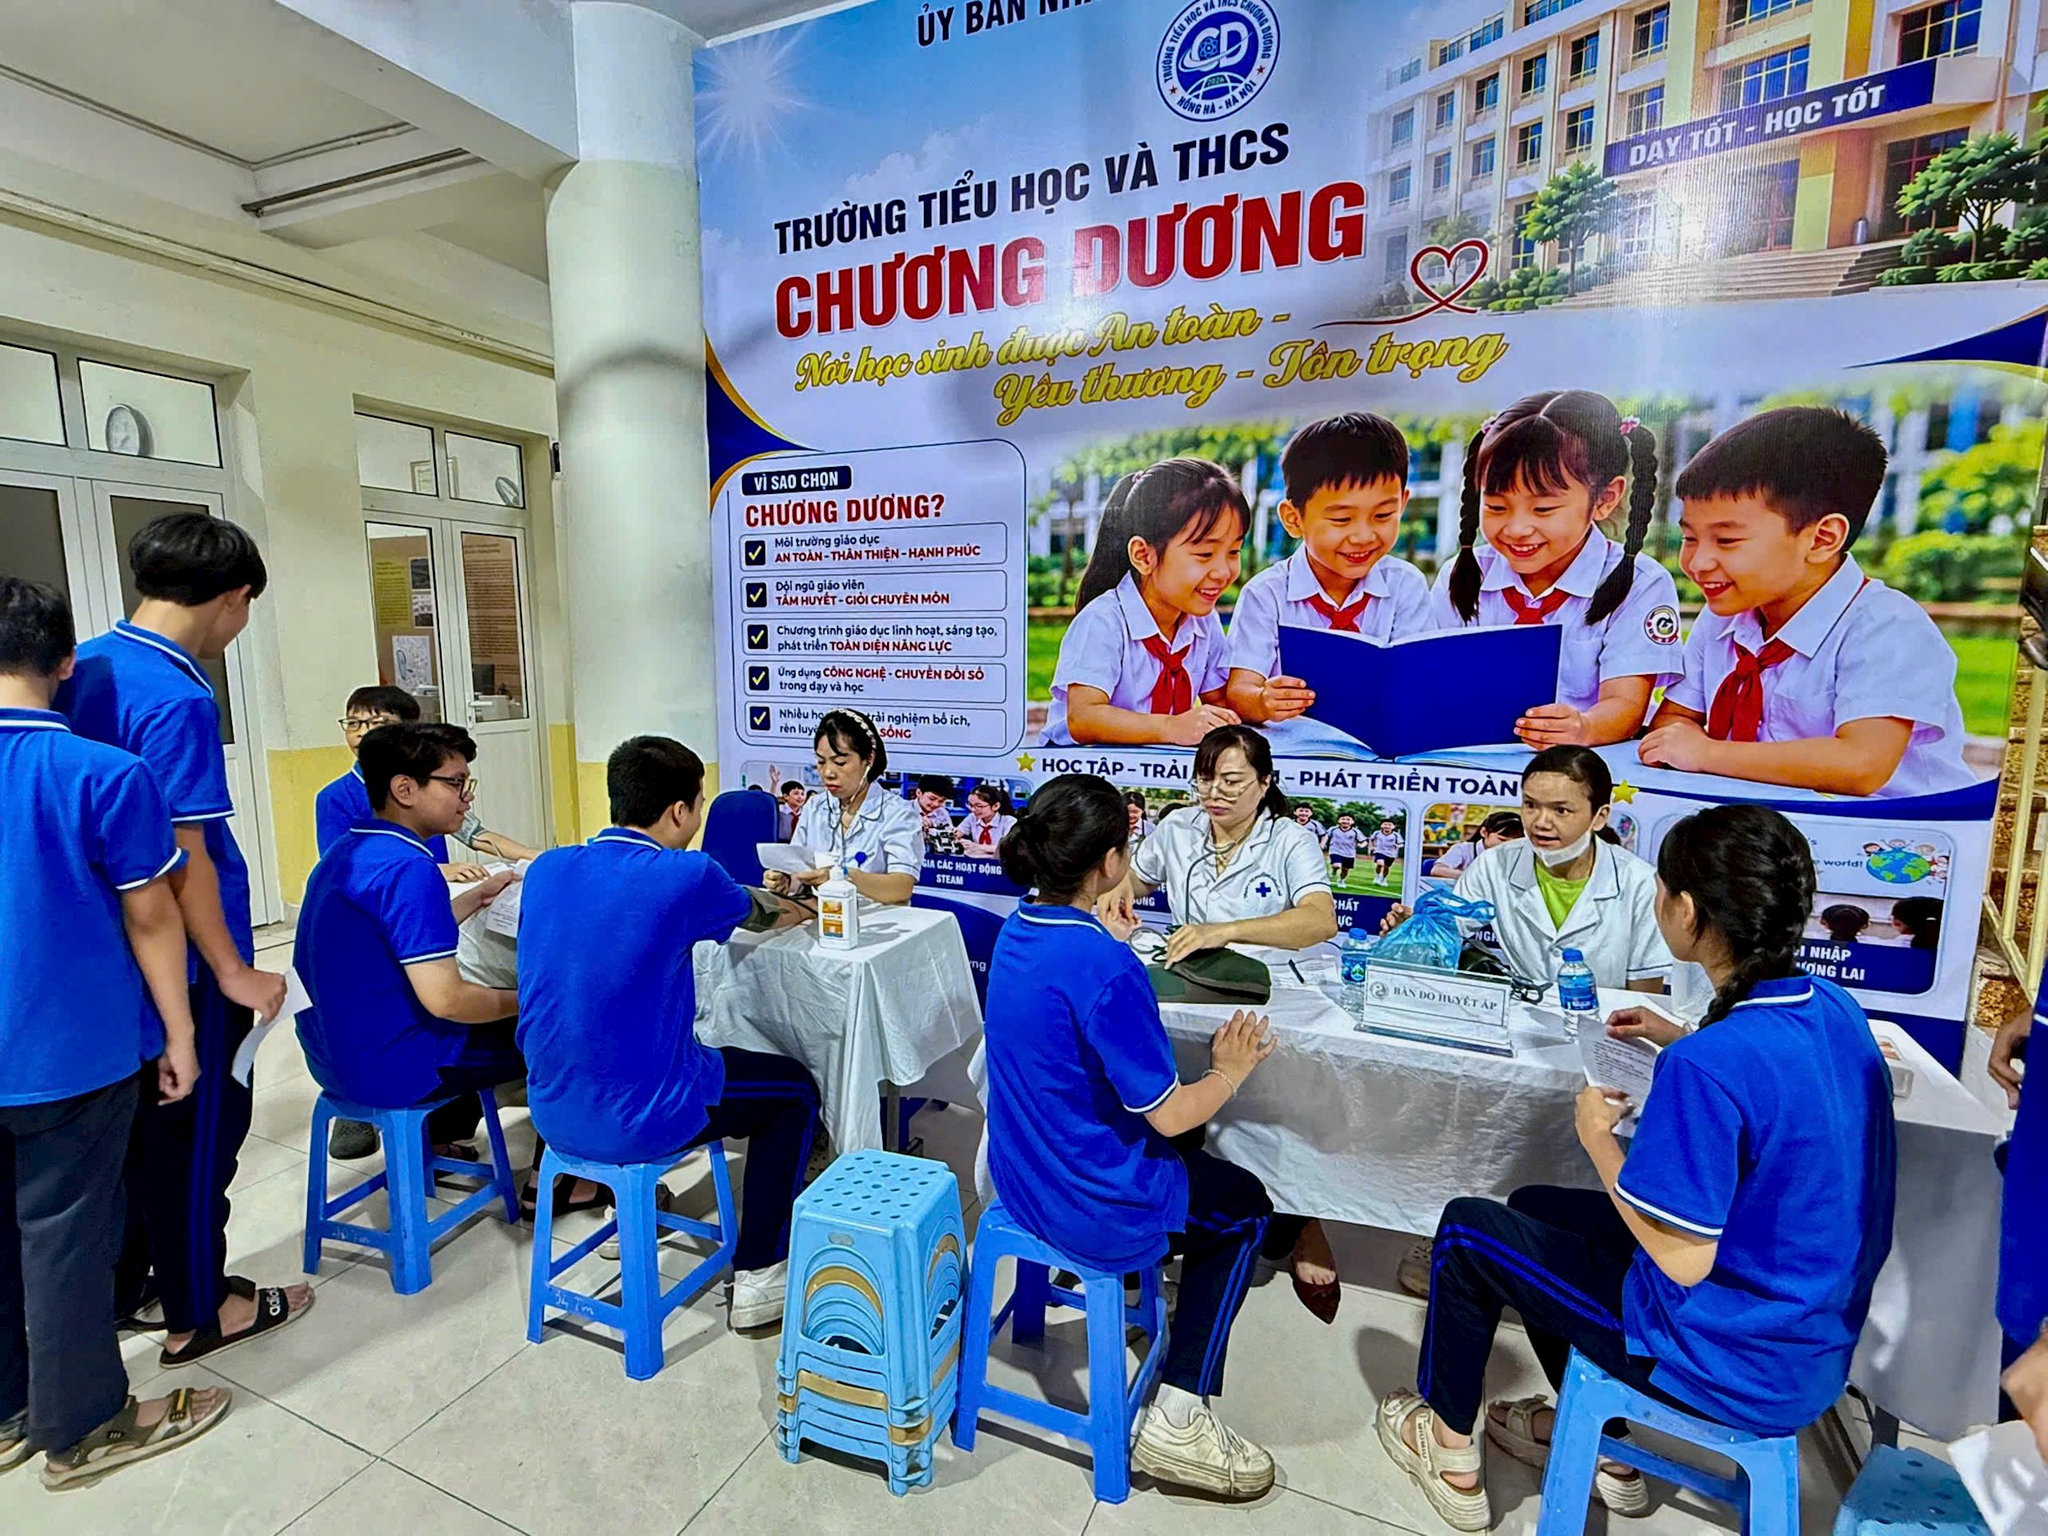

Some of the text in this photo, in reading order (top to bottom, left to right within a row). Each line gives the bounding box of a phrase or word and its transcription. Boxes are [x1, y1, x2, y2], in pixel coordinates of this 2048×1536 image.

[917, 0, 1025, 47] ỦY BAN
[1629, 136, 1682, 166] DẠY
[1691, 118, 1737, 151] TỐT
[1765, 101, 1822, 134] HỌC
[1832, 81, 1885, 117] TỐT
[774, 123, 1289, 254] TRƯỜNG TIỂU HỌC VÀ THCS
[775, 181, 1366, 339] CHƯƠNG DƯƠNG
[795, 350, 853, 392] Nơi
[853, 345, 913, 387] học
[914, 330, 993, 376] sinh
[1088, 311, 1159, 358] An
[1162, 302, 1263, 346] toàn
[993, 372, 1077, 427] Yêu
[1080, 362, 1227, 409] thương
[1262, 338, 1364, 388] Tôn
[1365, 330, 1510, 383] trọng
[754, 471, 839, 491] VÌ SAO CHỌN
[745, 493, 945, 527] CHƯƠNG DƯƠNG?
[775, 534, 880, 548] Môi trường giáo dục
[775, 552, 790, 563] AN
[792, 549, 822, 562] TOÀN
[830, 548, 862, 561] THÂN
[864, 547, 899, 562] THIỆN
[908, 547, 943, 561] HẠNH
[947, 543, 981, 557] PHÚC
[795, 580, 814, 593] ngũ
[817, 579, 840, 592] giáo
[801, 591, 837, 605] HUYẾT
[871, 592, 918, 604] CHUYÊN
[921, 591, 949, 604] MÔN
[777, 626, 816, 637] Chương
[845, 625, 867, 637] giáo
[870, 625, 889, 638] dục
[892, 625, 913, 635] linh
[916, 625, 943, 638] hoạt,
[946, 624, 973, 638] sáng
[976, 625, 997, 638] tạo,
[778, 640, 801, 652] phát
[829, 639, 860, 651] TOÀN
[863, 639, 889, 654] DIỆN
[892, 639, 926, 651] NĂNG
[929, 640, 952, 654] LỰC
[778, 666, 796, 678] Ứng
[798, 668, 821, 679] dụng
[823, 666, 853, 678] CÔNG
[856, 666, 886, 681] NGHỆ
[968, 665, 984, 680] SỐ
[779, 681, 864, 694] trong dạy và học
[888, 712, 930, 726] nghiệm
[950, 714, 970, 727] ích,
[880, 725, 911, 738] SỐNG
[1140, 758, 1188, 779] TRẢI
[1300, 768, 1362, 789] PHÁT
[1366, 767, 1439, 792] TRIỂN
[1446, 774, 1518, 797] TOÀN
[922, 859, 1002, 875] GIA CÁC HOẠT ĐỘNG
[1823, 859, 1863, 868] world!
[936, 874, 963, 885] STEAM
[1337, 915, 1353, 928] ỰC
[1810, 945, 1851, 963] NHẬP
[1841, 967, 1865, 980] LAI
